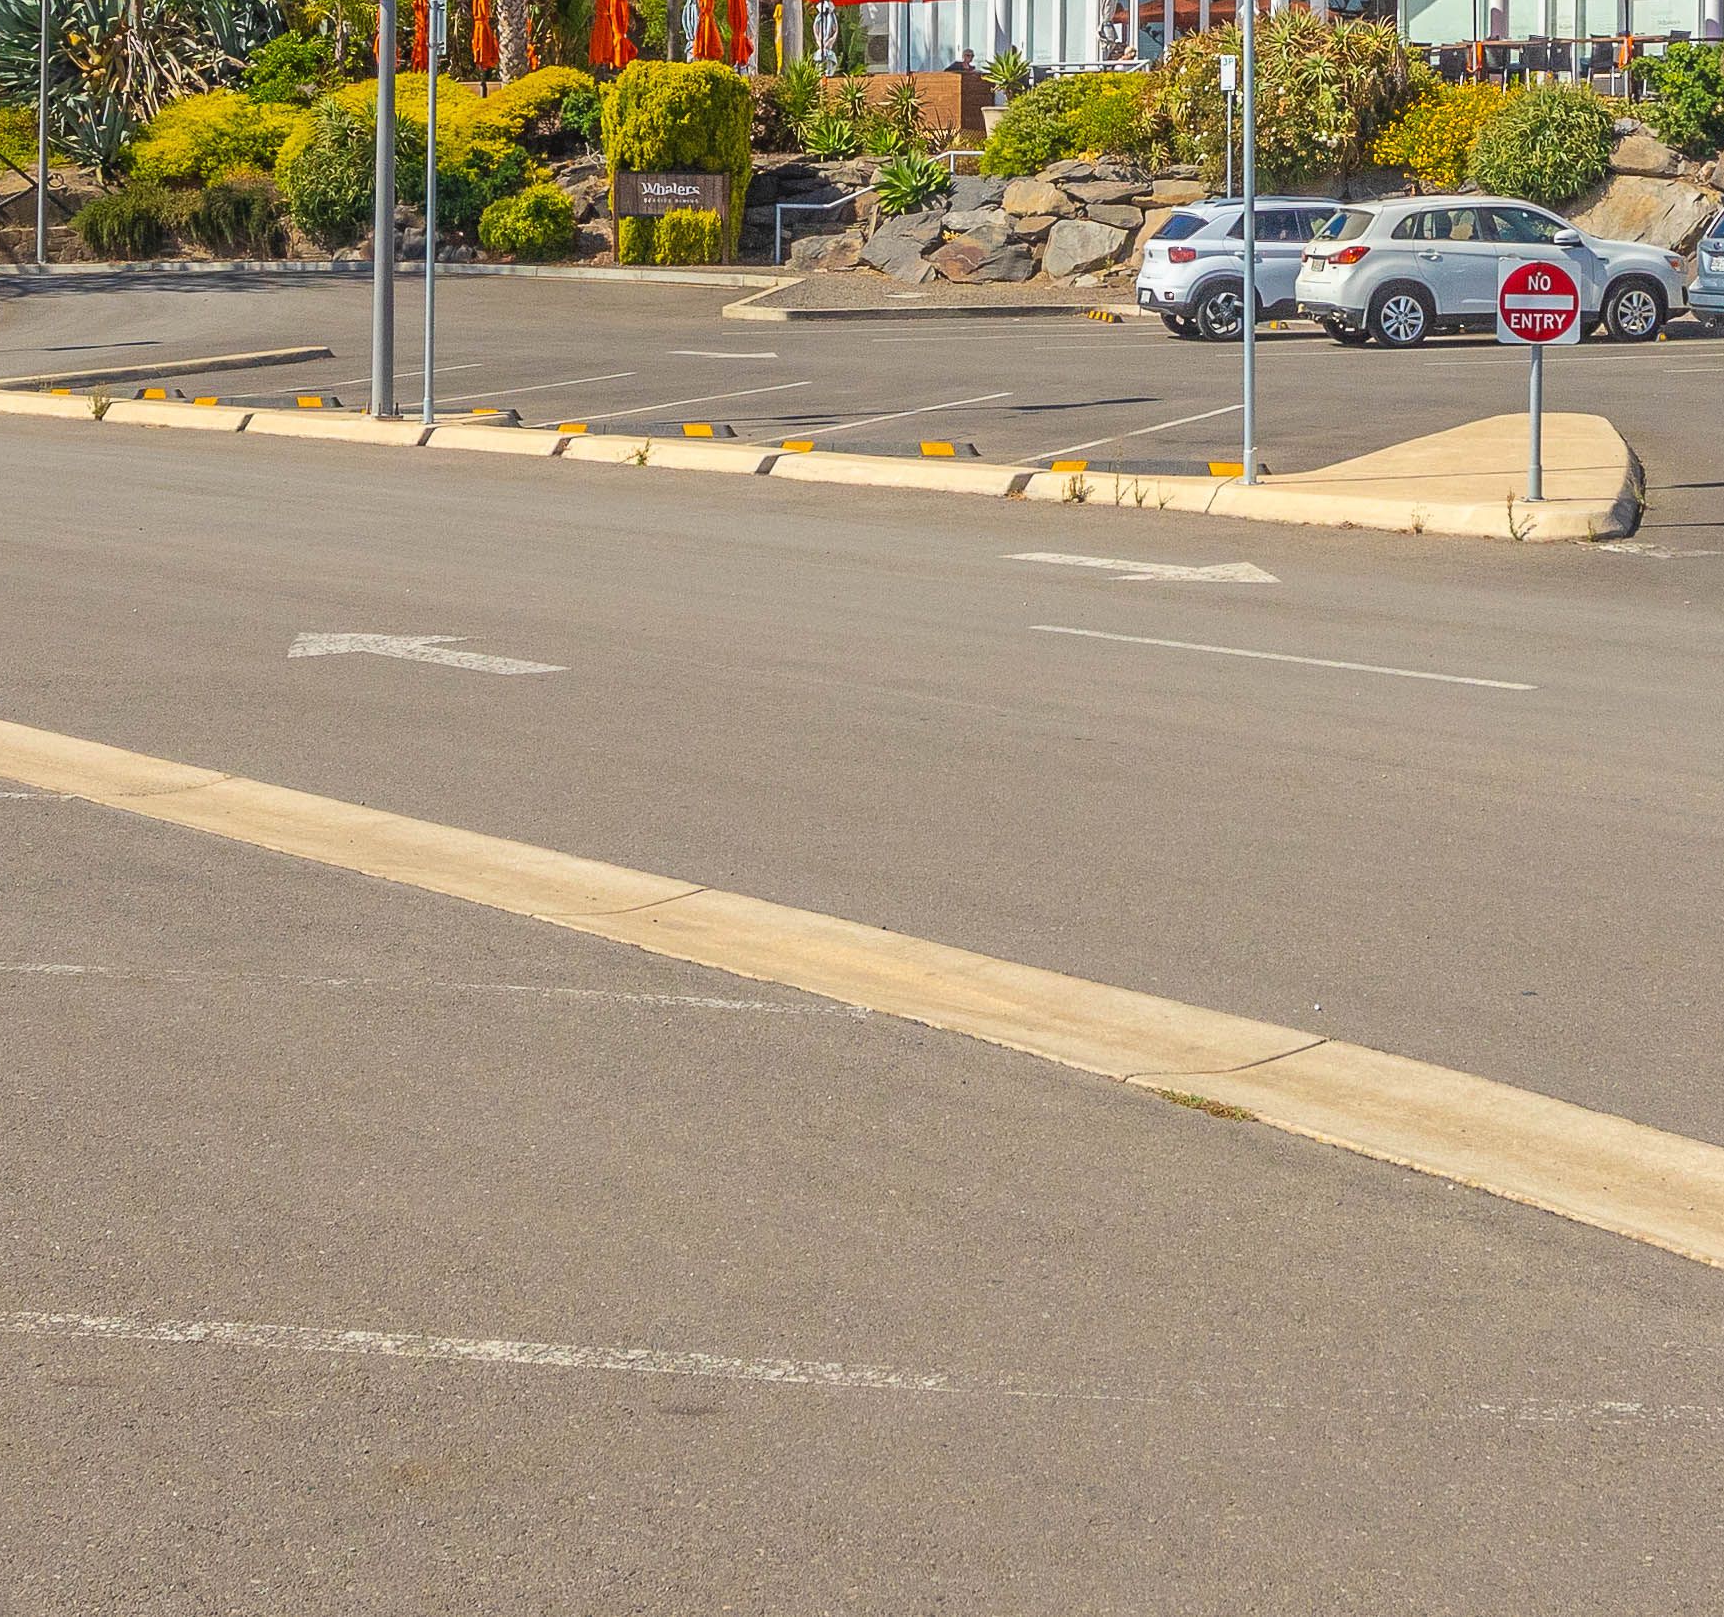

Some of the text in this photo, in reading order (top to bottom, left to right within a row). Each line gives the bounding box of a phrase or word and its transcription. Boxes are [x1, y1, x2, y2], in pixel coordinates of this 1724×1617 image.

[641, 182, 700, 196] Whalers
[1528, 275, 1552, 292] NO
[1510, 313, 1567, 331] ENTRY
